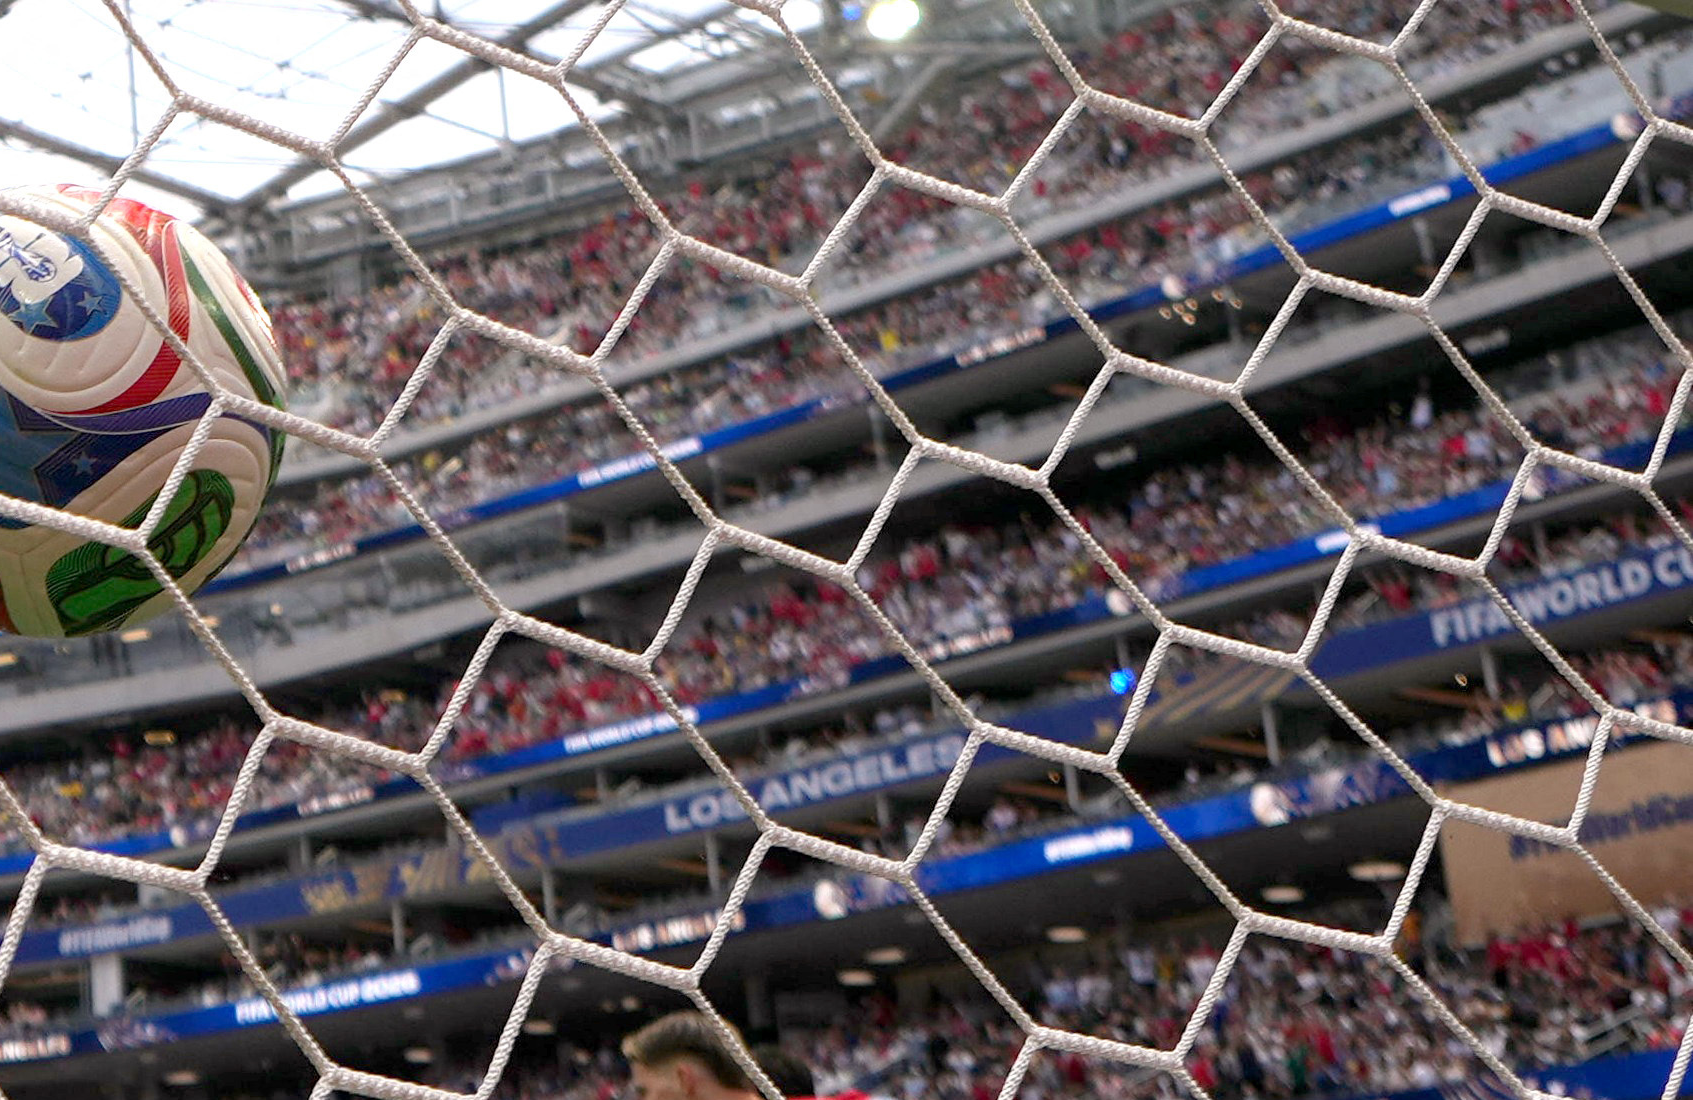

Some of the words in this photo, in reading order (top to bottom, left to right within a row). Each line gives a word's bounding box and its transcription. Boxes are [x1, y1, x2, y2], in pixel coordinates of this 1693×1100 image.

[1429, 602, 1511, 648] FIFA
[1511, 558, 1650, 627] WORLD
[759, 735, 965, 813] ANGELES
[329, 979, 360, 1009] CUP
